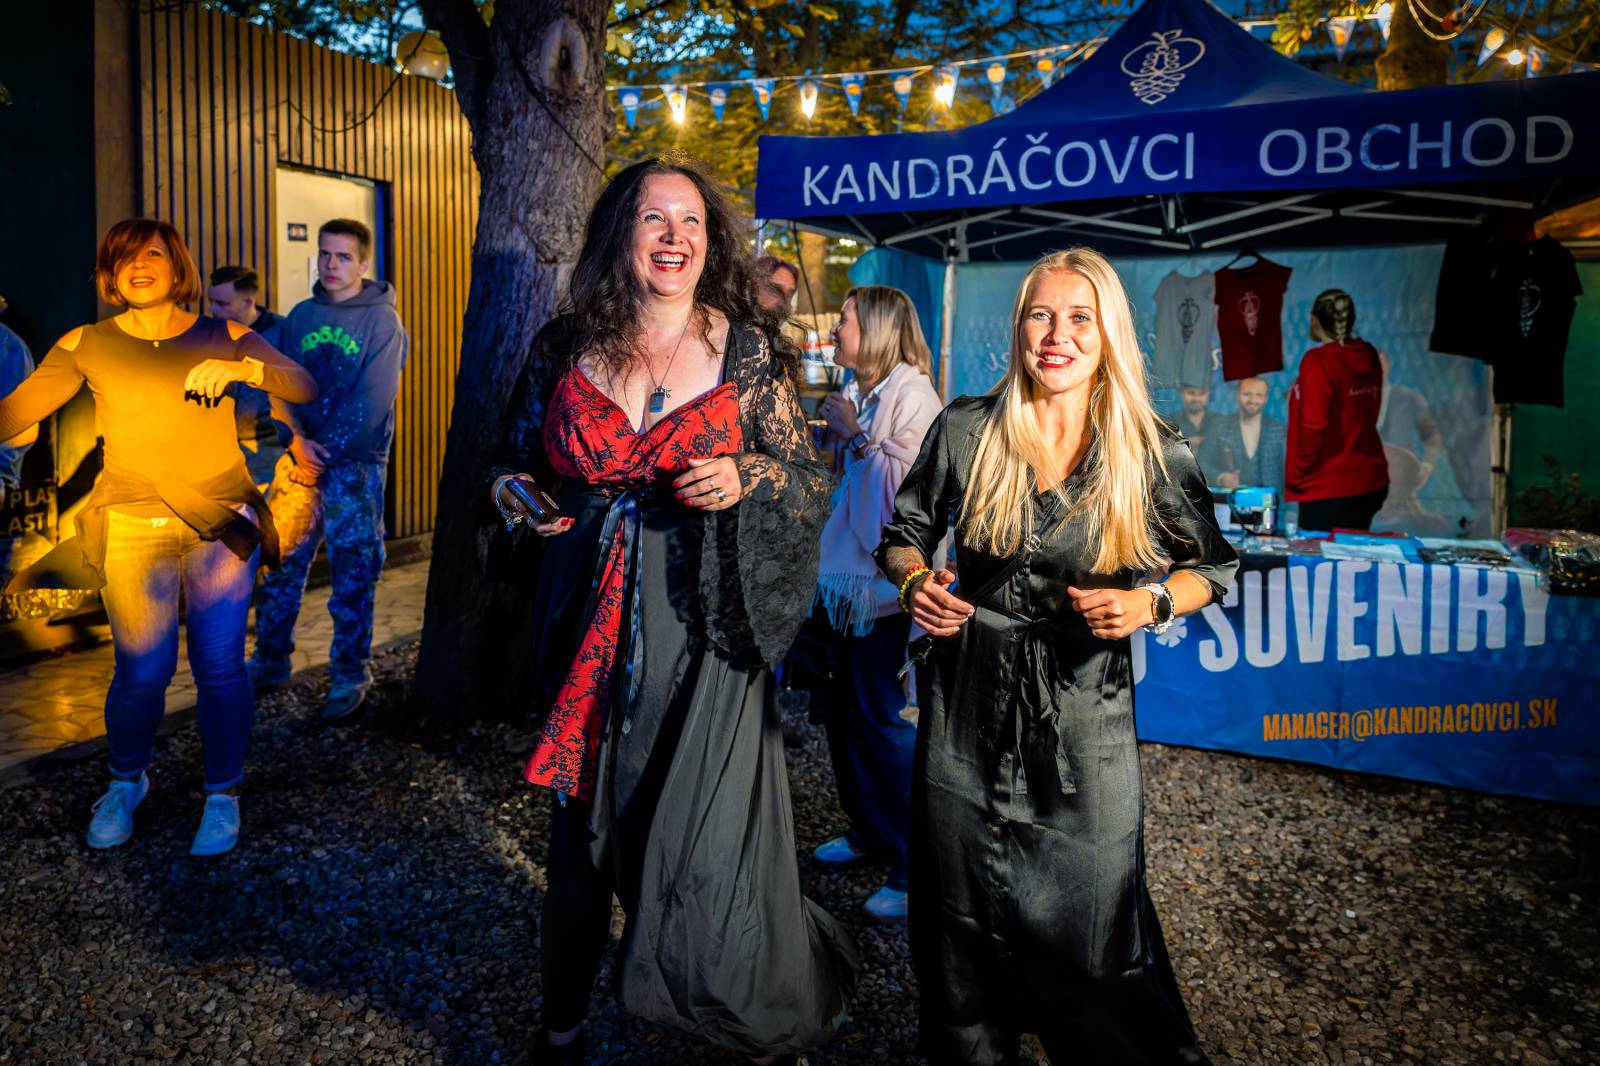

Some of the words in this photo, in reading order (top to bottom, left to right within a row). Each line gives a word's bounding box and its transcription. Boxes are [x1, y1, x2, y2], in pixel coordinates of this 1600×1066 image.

[802, 132, 1195, 206] KANDRÁČOVCI
[1259, 115, 1574, 176] OBCHOD
[1198, 561, 1551, 673] SUVENIRY
[1262, 698, 1559, 742] MANAGER@KANDRACOVCI.SK
